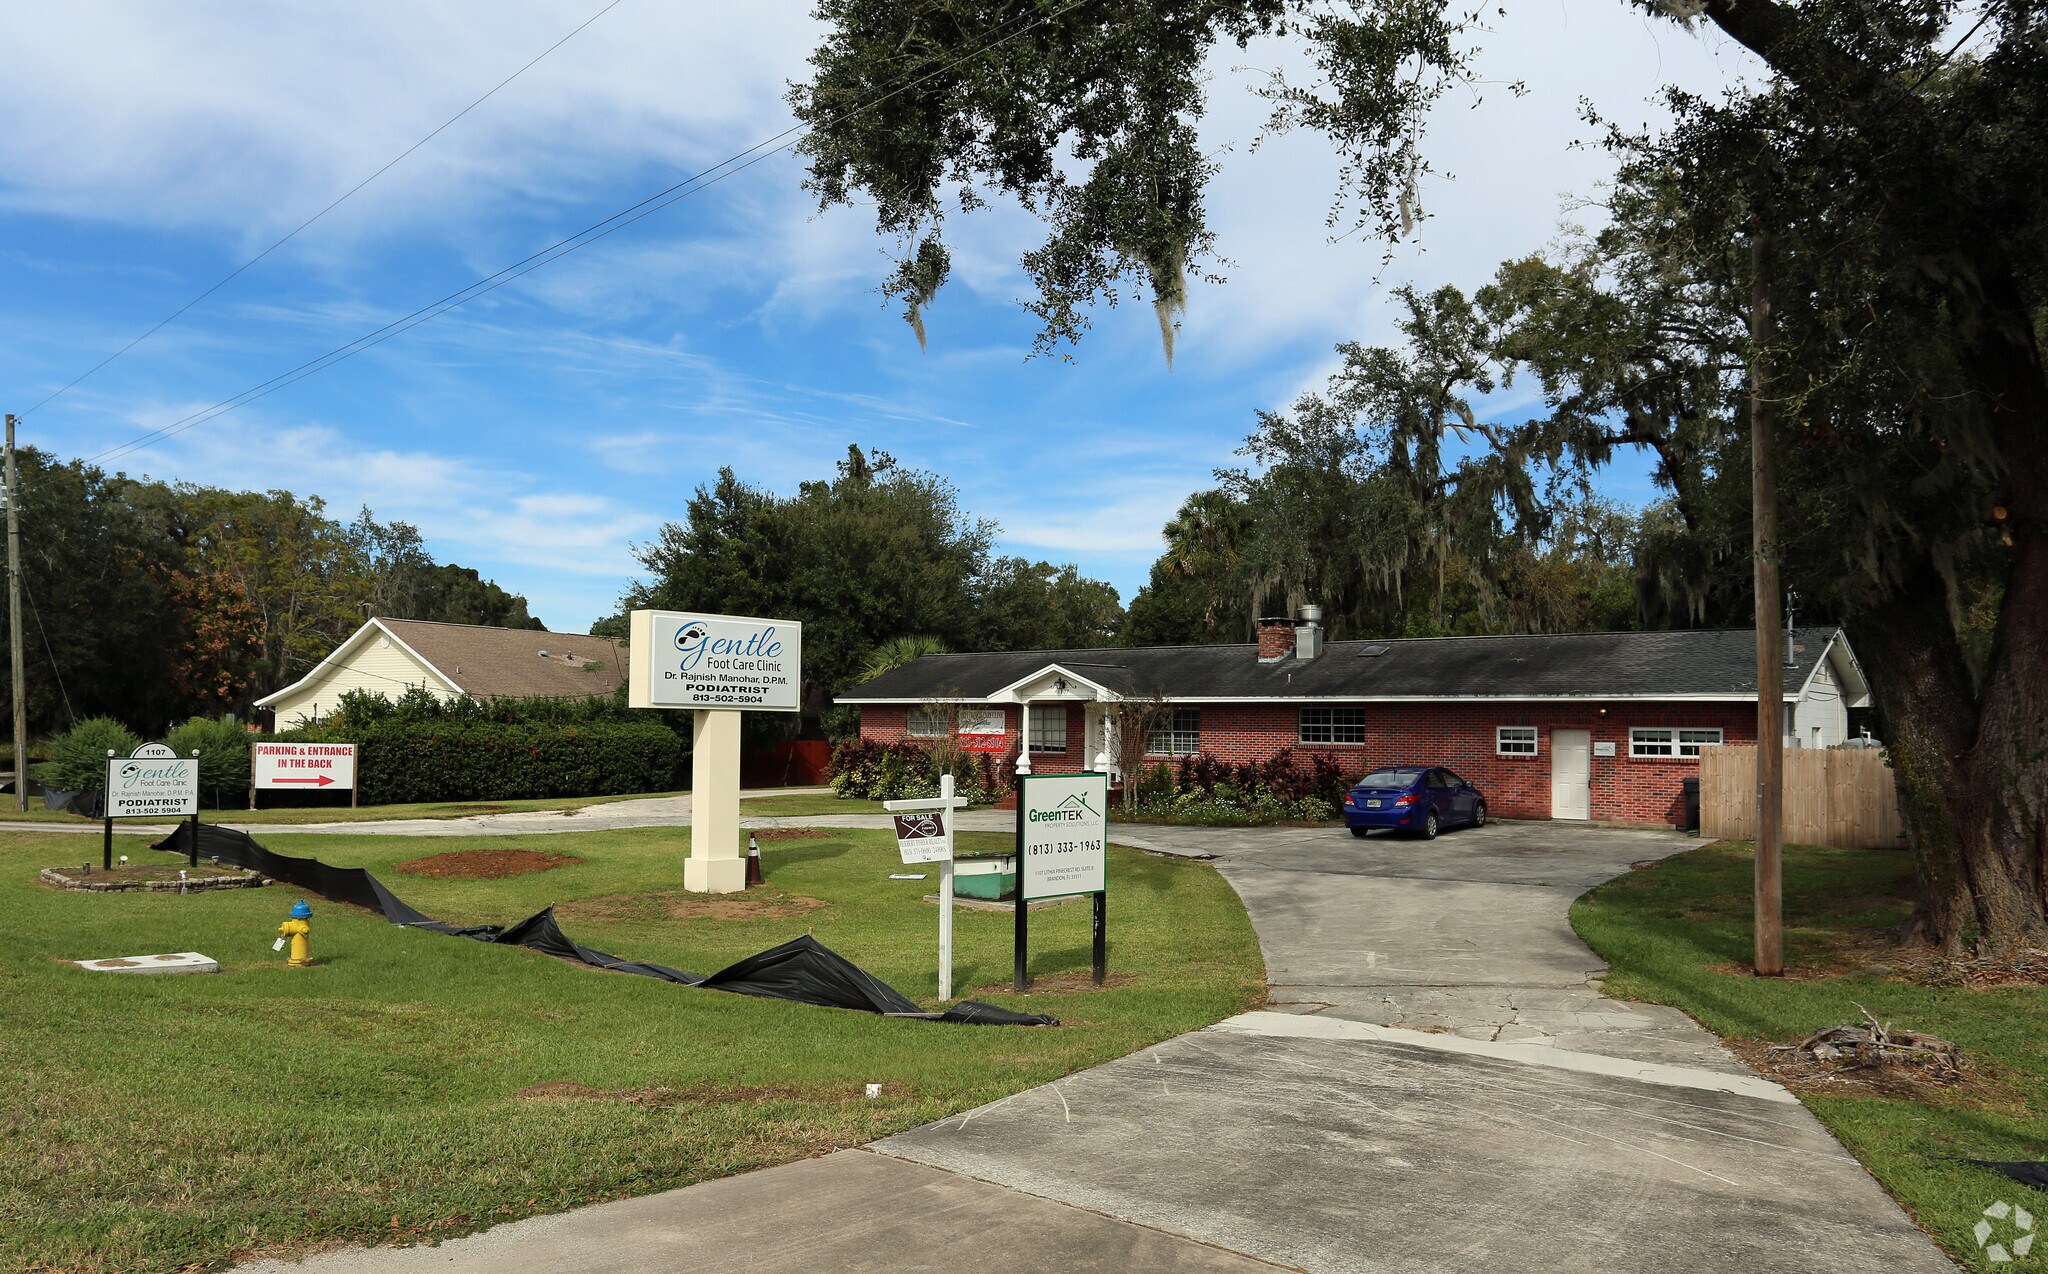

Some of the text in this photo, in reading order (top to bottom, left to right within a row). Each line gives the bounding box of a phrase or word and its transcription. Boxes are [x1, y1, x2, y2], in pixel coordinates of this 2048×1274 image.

[674, 621, 784, 671] Gentle
[707, 657, 782, 672] Foot Care Clinic
[664, 671, 788, 685] Dr. Rajnish Manohar, D.P.M.
[686, 684, 770, 694] PODIATRIST
[693, 694, 763, 703] 813-502-5904
[258, 746, 352, 756] PARKING & ENTRANCE
[278, 759, 332, 768] IN THE BACK
[120, 761, 189, 789] Gentle
[119, 799, 188, 807] PODIATRIST
[1029, 809, 1083, 822] GreenTEK
[1029, 840, 1100, 855] (813) 333-1963
